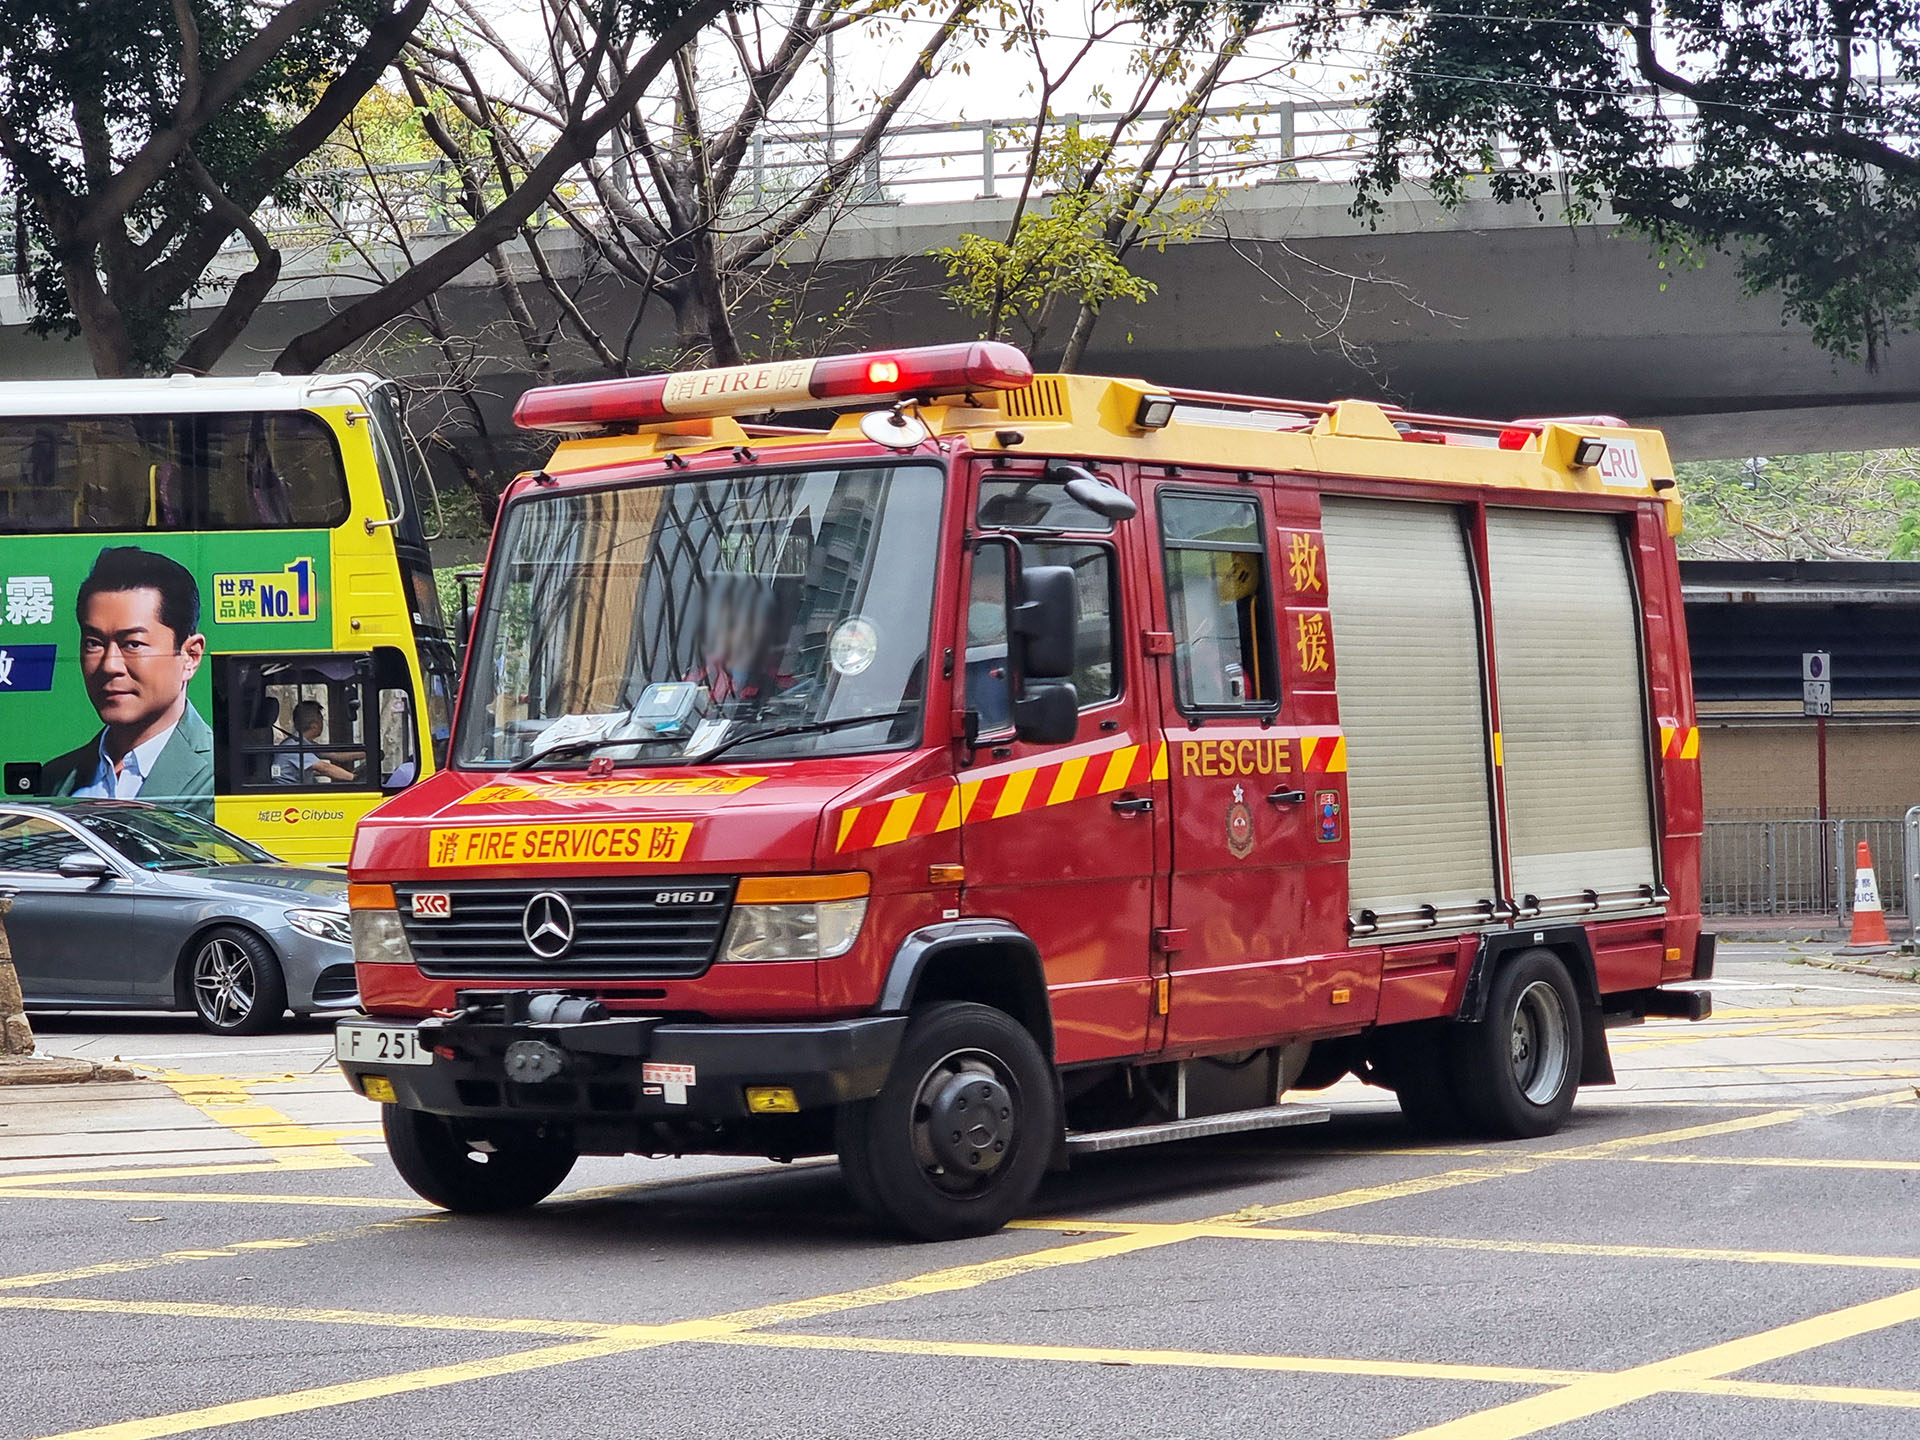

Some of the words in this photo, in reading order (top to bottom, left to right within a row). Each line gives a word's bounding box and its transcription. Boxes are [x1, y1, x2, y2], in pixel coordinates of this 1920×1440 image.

[671, 375, 696, 400] 消
[701, 369, 771, 395] FIRE
[775, 365, 807, 390] 防
[218, 579, 256, 597] 世界
[0, 575, 54, 625] 霧
[220, 600, 256, 618] 品牌
[1288, 533, 1329, 672] 救援
[1819, 684, 1825, 695] 7
[1820, 702, 1830, 714] 12
[1181, 739, 1292, 777] RESCUE
[521, 780, 693, 800] RESCUE
[258, 810, 282, 822] 城巴
[301, 809, 344, 821] Citybus
[436, 832, 459, 864] 消
[466, 831, 519, 861] FIRE
[522, 828, 640, 859] SERVICES
[649, 826, 679, 859] 防
[655, 891, 696, 904] 816
[698, 891, 715, 903] D
[352, 1031, 362, 1057] F
